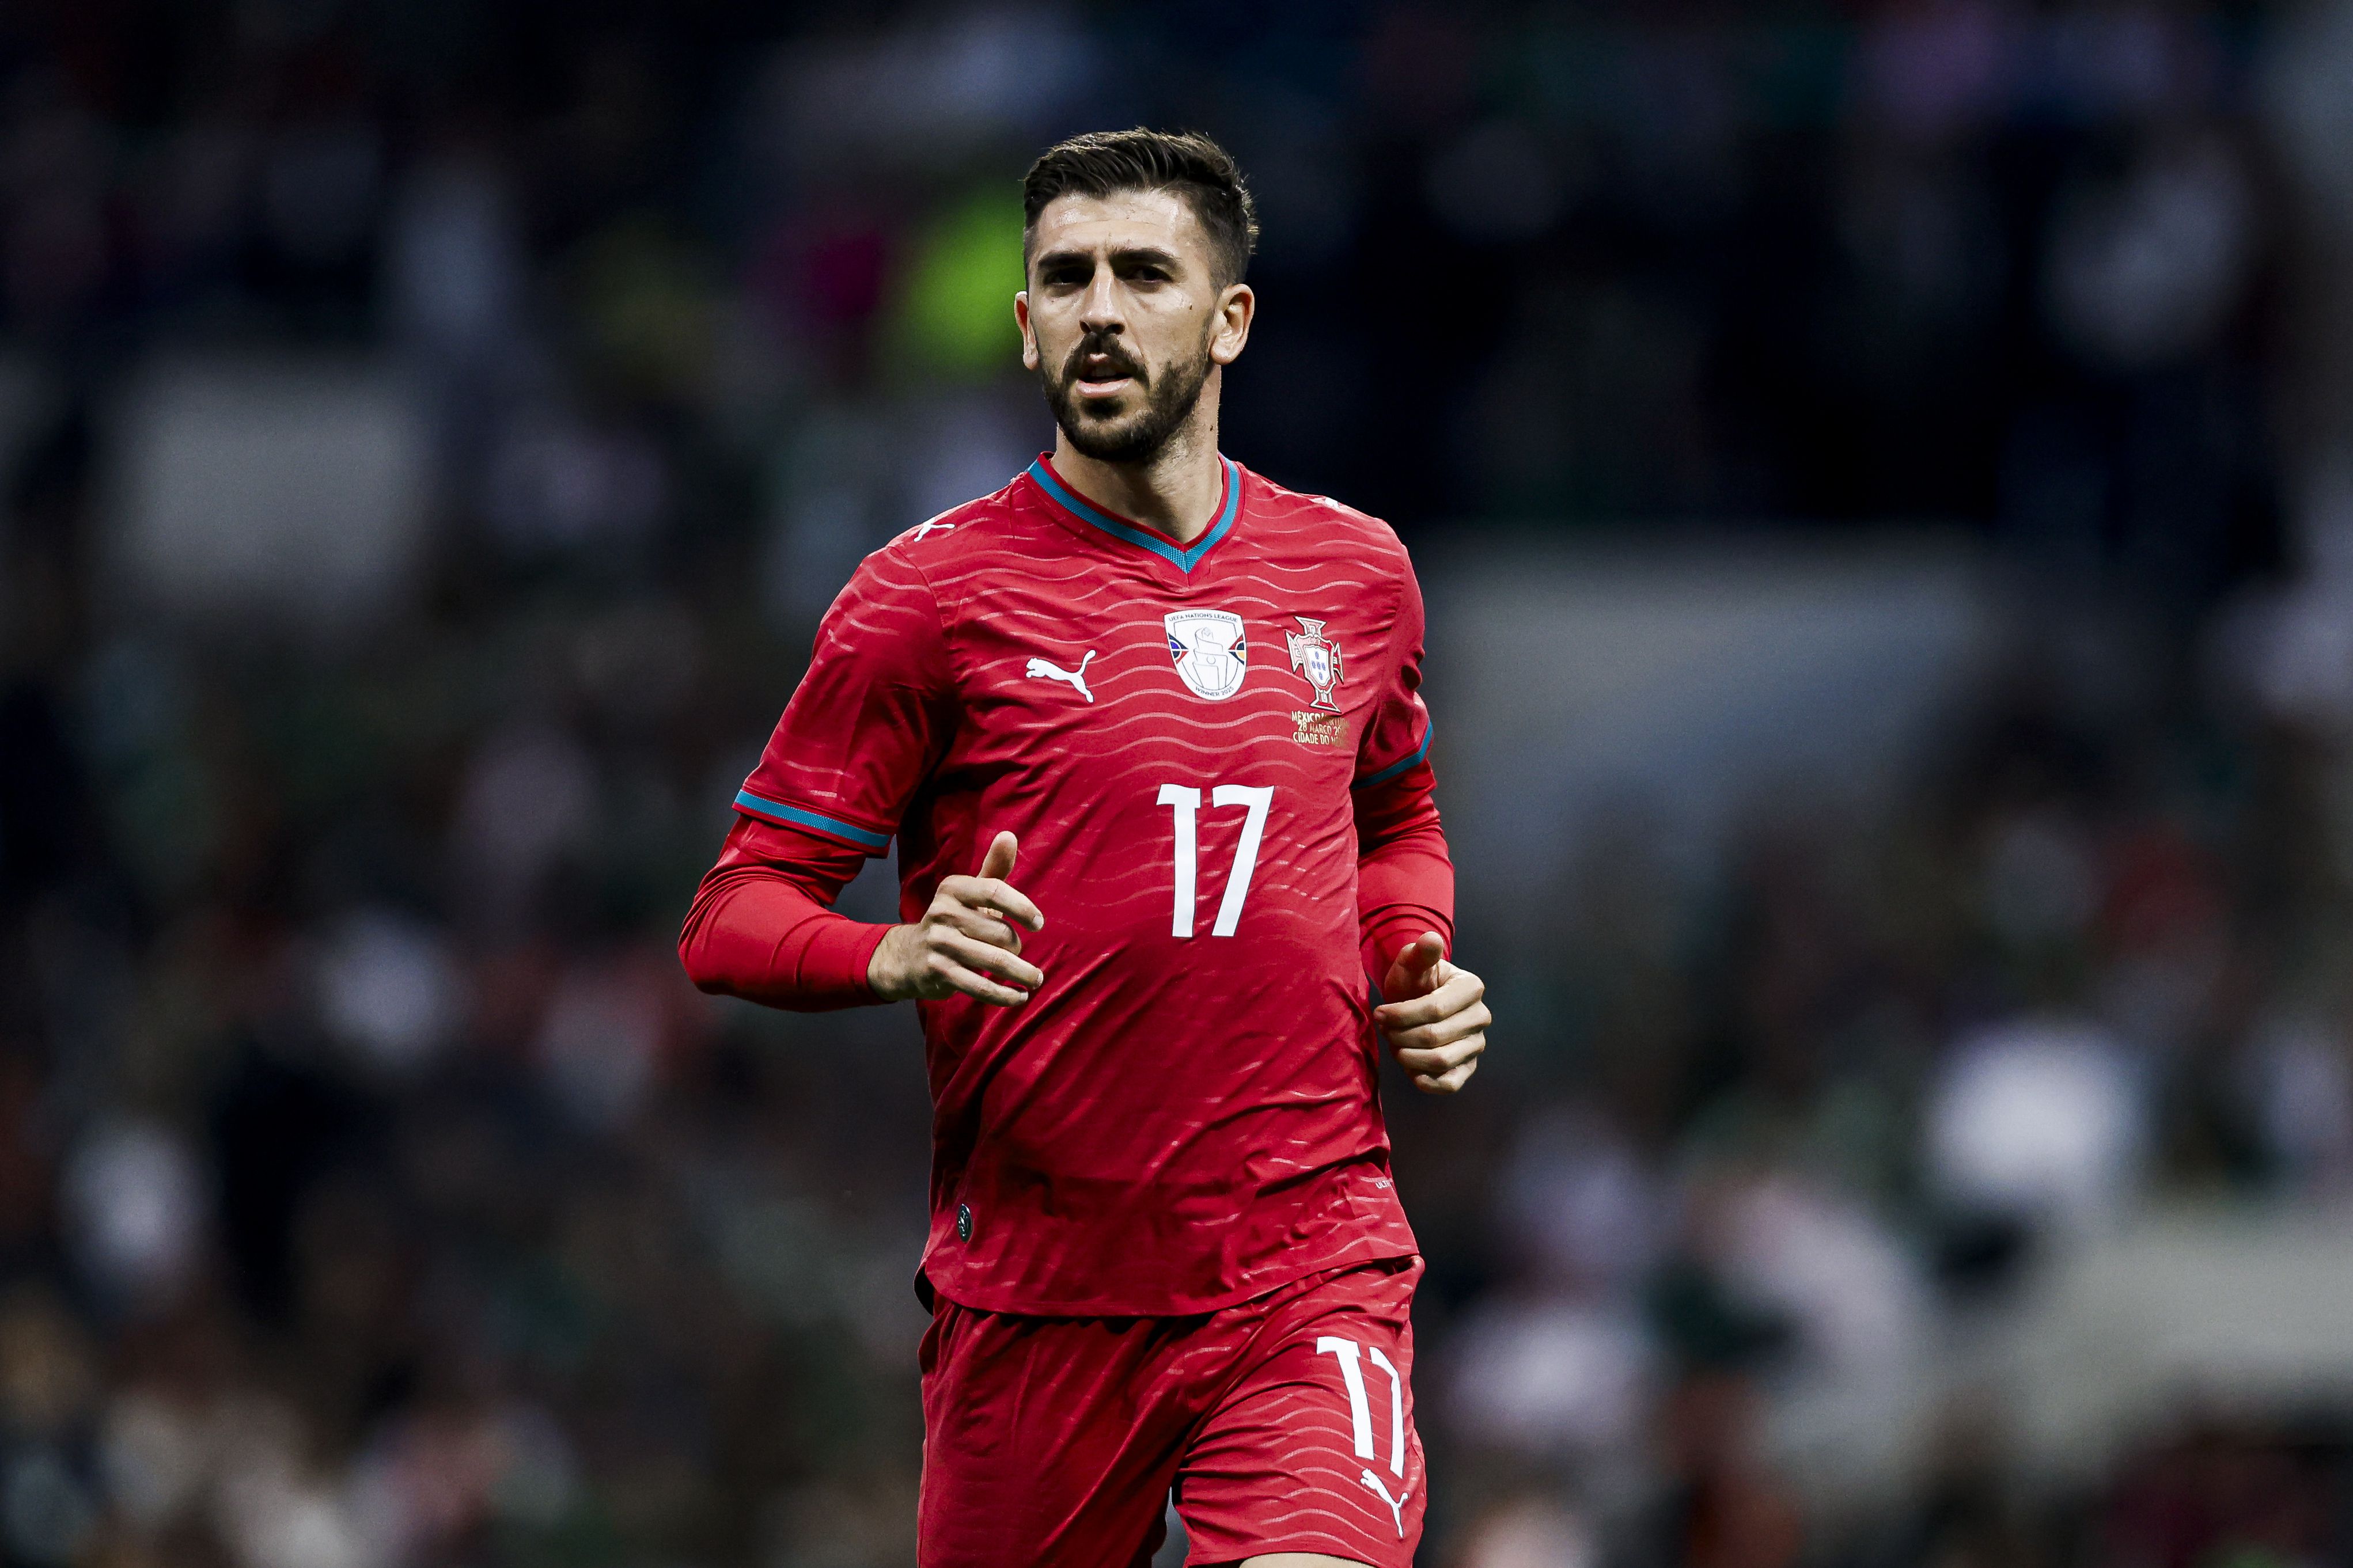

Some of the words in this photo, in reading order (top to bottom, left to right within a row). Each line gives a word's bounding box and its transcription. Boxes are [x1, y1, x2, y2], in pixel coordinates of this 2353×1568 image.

[1214, 613, 1238, 622] LEAGUE
[1195, 686, 1220, 696] WINNER
[1221, 685, 1234, 695] 2025
[1298, 721, 1308, 732] 28
[1293, 731, 1319, 745] CIDADE
[1320, 734, 1330, 745] DO
[1156, 783, 1275, 937] 17
[1316, 1336, 1405, 1479] 17
